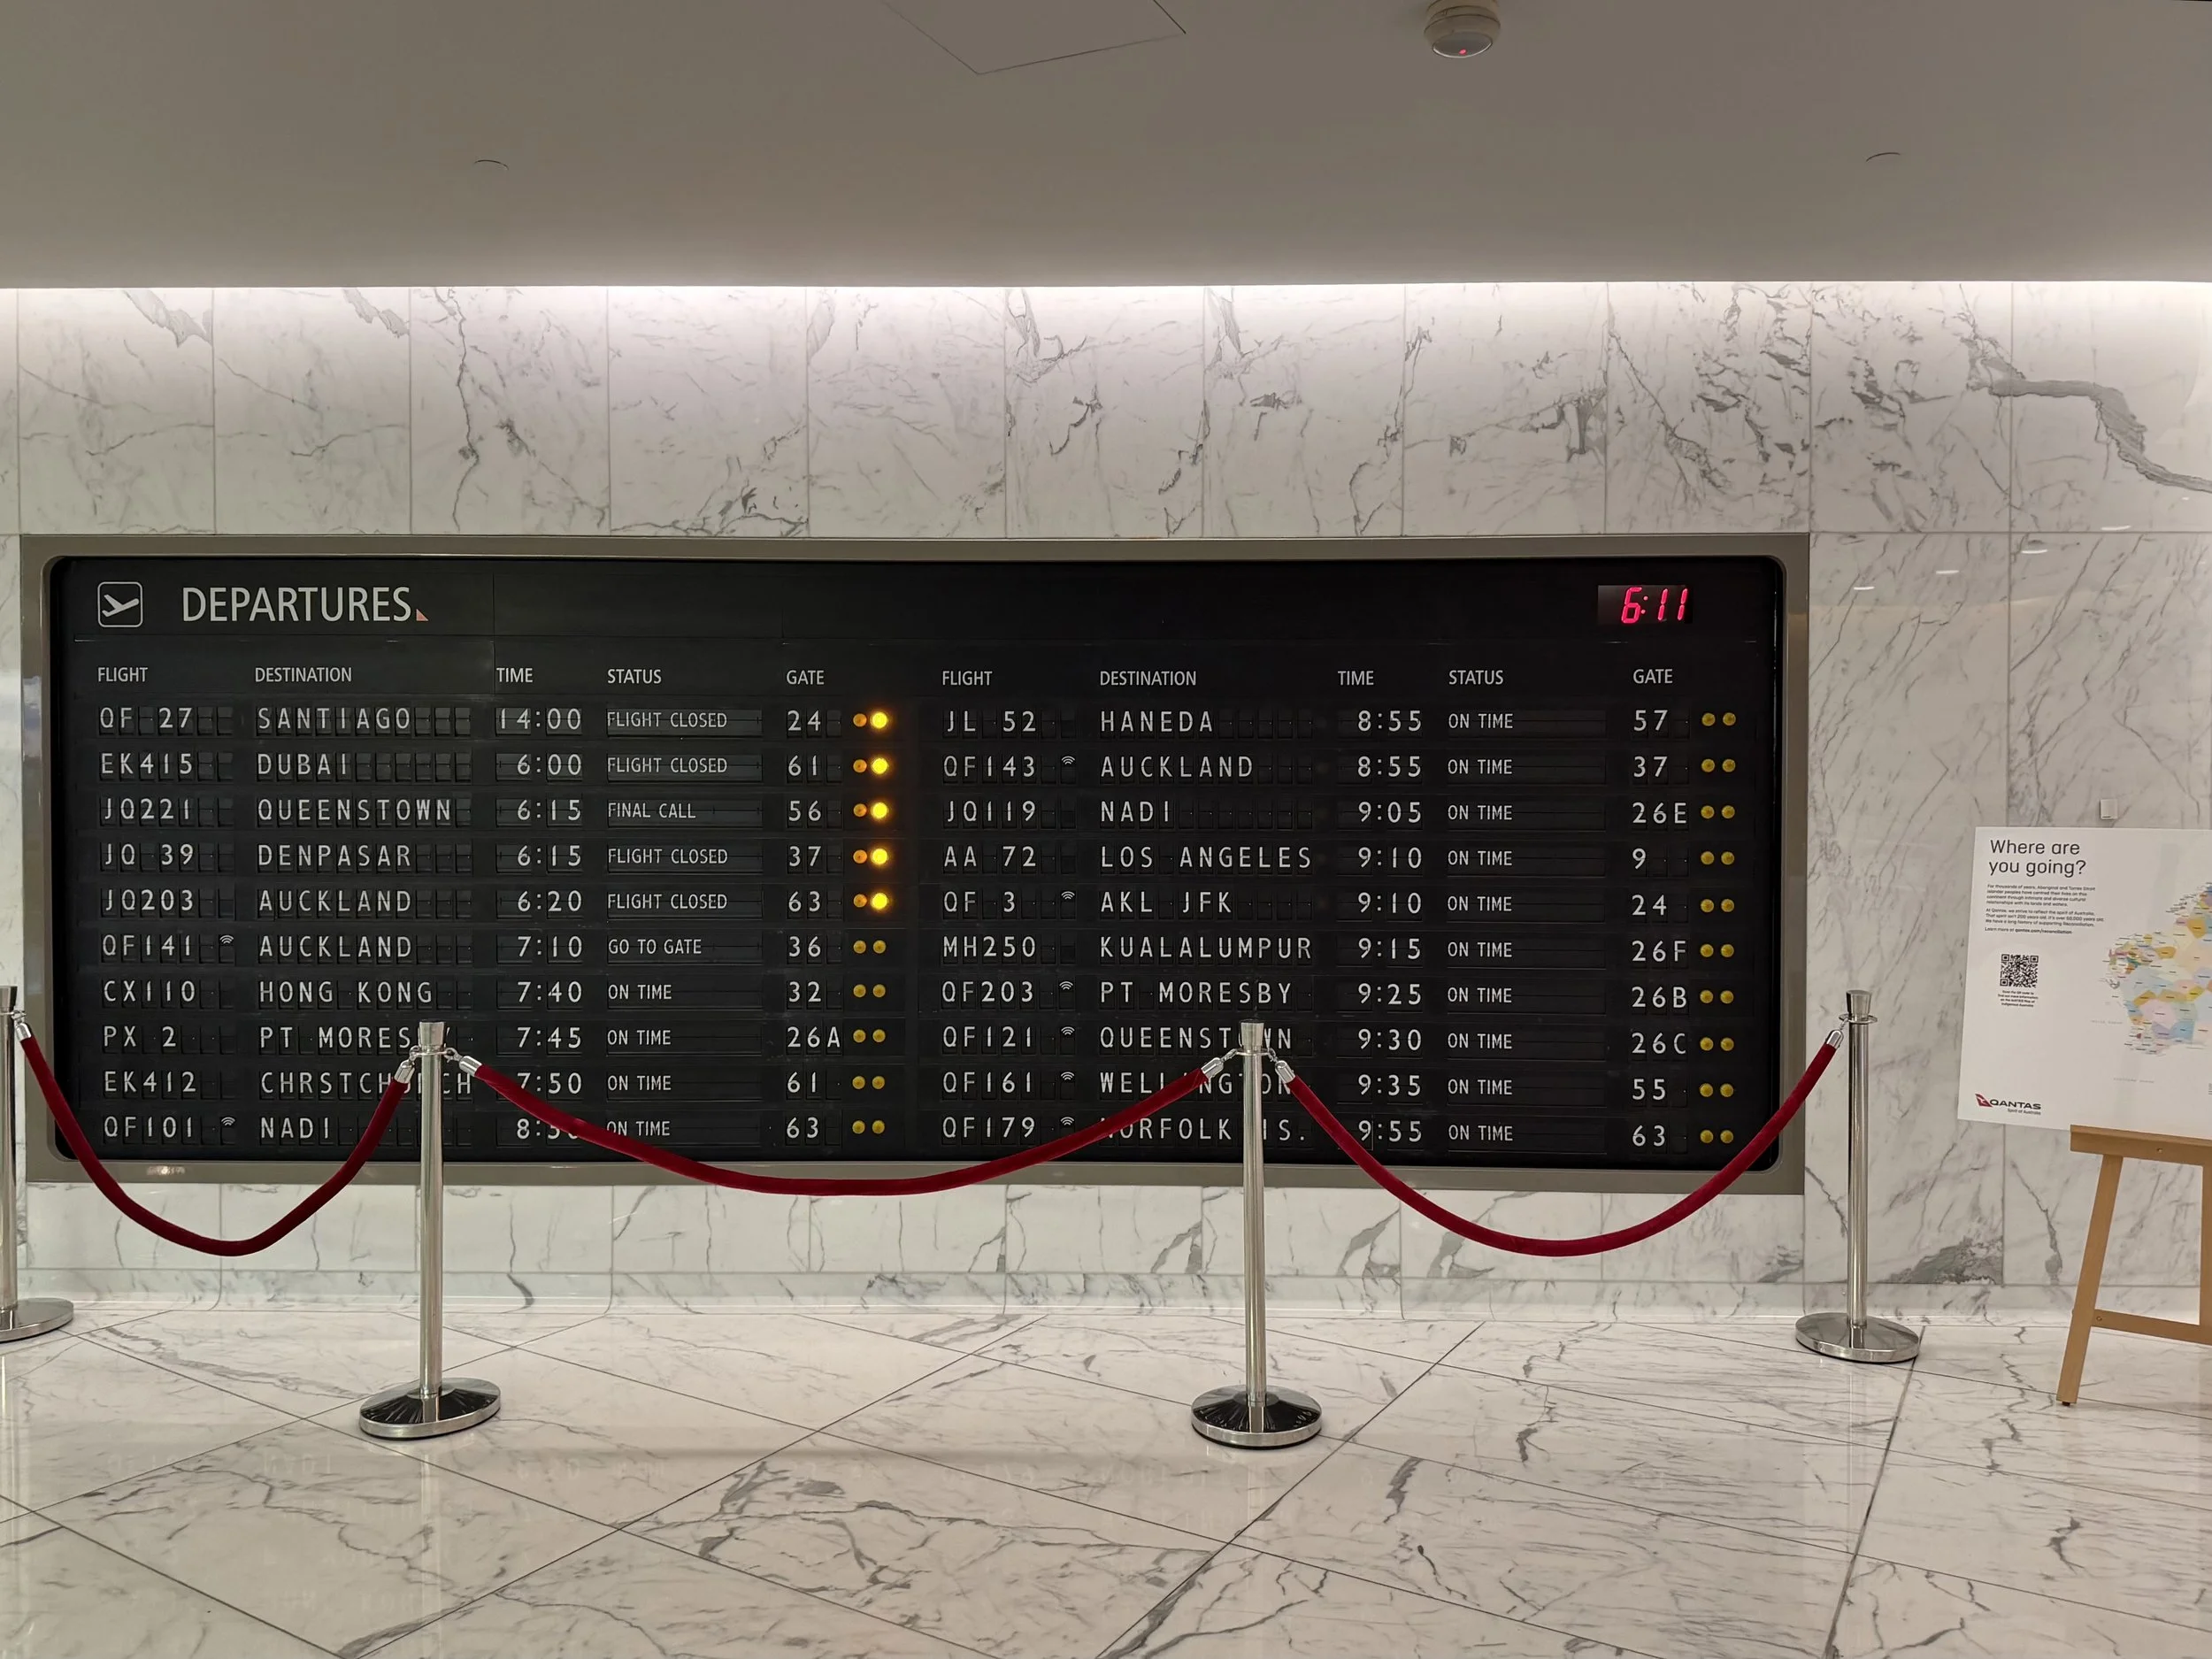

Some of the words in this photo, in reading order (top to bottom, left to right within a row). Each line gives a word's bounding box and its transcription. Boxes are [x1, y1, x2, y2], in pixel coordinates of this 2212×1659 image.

[182, 587, 411, 622] DEPARTURES
[1621, 587, 1688, 624] 6:11
[96, 665, 150, 684] FLIGHT
[254, 665, 353, 684] DESTINATION
[495, 666, 534, 684] TIME
[606, 667, 663, 685] STATUS
[785, 669, 826, 686] GATE
[941, 670, 994, 687] FLIGHT
[1099, 670, 1197, 687] DESTINATION
[1336, 669, 1375, 687] TIME
[1448, 669, 1505, 686] STATUS
[1632, 667, 1674, 685] GATE
[258, 707, 410, 729] SANTIAGO
[501, 707, 581, 730] 14:00
[607, 711, 662, 727] FLIGHT
[670, 711, 727, 728] CLOSED
[787, 710, 821, 732] 24
[1101, 710, 1212, 733] HANEDA
[1357, 710, 1421, 732] 8:55
[1448, 713, 1470, 729] ON
[1478, 713, 1513, 729] TIME
[1633, 710, 1668, 732] 57
[101, 752, 192, 774] EK415
[257, 753, 346, 775] DUBAI
[517, 753, 581, 776] 6:00
[607, 757, 662, 773] FLIGHT
[670, 757, 727, 773] CLOSED
[787, 755, 817, 777] 61
[943, 755, 1035, 778] QF143
[1101, 756, 1252, 778] AUCKLAND
[1357, 756, 1421, 778] 8:55
[1448, 759, 1469, 774] ON
[1477, 759, 1513, 774] TIME
[1633, 756, 1668, 778] 37
[104, 797, 189, 820] JQ221
[257, 798, 450, 821] QUEENSTOWN
[517, 799, 581, 821] 6:15
[608, 802, 651, 818] FINAL
[658, 803, 696, 818] CALL
[788, 800, 821, 822] 56
[947, 800, 1036, 822] JQ119
[1101, 800, 1169, 822] NADI
[1358, 801, 1421, 824] 9:05
[1448, 804, 1469, 820] ON
[1477, 804, 1513, 820] TIME
[1632, 802, 1686, 824] 26E
[258, 844, 411, 866] DENPASAR
[517, 845, 581, 867] 6:15
[608, 848, 663, 864] FLIGHT
[671, 849, 728, 864] CLOSED
[789, 845, 822, 867] 37
[1102, 846, 1153, 868] LOS
[1179, 846, 1310, 869] ANGELES
[1358, 847, 1422, 869] 9:10
[1448, 849, 1469, 865] ON
[1477, 850, 1513, 866] TIME
[1632, 848, 1647, 870] 9
[1989, 839, 2046, 856] Where
[2051, 841, 2081, 856] are
[1988, 859, 2020, 875] you
[2025, 859, 2086, 878] going?
[105, 888, 193, 911] JQ203
[259, 889, 411, 912] AUCKLAND
[518, 889, 582, 912] 6:20
[608, 893, 663, 910] FLIGHT
[670, 894, 727, 910] CLOSED
[788, 890, 821, 912] 63
[1101, 891, 1153, 913] AKL
[1182, 891, 1232, 913] JFK
[1357, 892, 1422, 914] 9:10
[1447, 895, 1469, 911] ON
[1477, 895, 1512, 911] TIME
[1632, 894, 1667, 916] 24
[103, 934, 190, 956] QF141
[259, 935, 411, 957] AUCKLAND
[518, 935, 582, 957] 7:10
[608, 939, 630, 955] GO
[637, 939, 657, 955] TO
[664, 939, 702, 955] GATE
[788, 935, 821, 957] 36
[943, 935, 1035, 957] MH250
[1101, 936, 1311, 959] KUALALUMPUR
[1358, 937, 1421, 960] 9:15
[1448, 941, 1469, 957] ON
[1477, 941, 1512, 957] TIME
[1632, 940, 1686, 963] 26F
[104, 979, 196, 1002] CX110
[259, 980, 333, 1002] HONG
[357, 981, 432, 1003] KONG
[517, 980, 582, 1003] 7:40
[608, 984, 629, 1000] ON
[637, 984, 672, 1000] TIME
[788, 980, 822, 1002] 32
[941, 980, 1033, 1002] QF203
[1101, 981, 1133, 1003] PT
[1159, 981, 1291, 1004] MORESBY
[1358, 982, 1421, 1005] 9:25
[1448, 987, 1469, 1002] ON
[1477, 987, 1512, 1003] TIME
[1632, 986, 1687, 1009] 26B
[260, 1026, 293, 1048] PT
[517, 1026, 581, 1048] 7:45
[607, 1029, 628, 1046] ON
[636, 1029, 672, 1046] TIME
[787, 1025, 841, 1048] 26A
[943, 1025, 1031, 1048] QF121
[1100, 1026, 1291, 1049] QUEENSTWN
[1358, 1028, 1422, 1051] 9:30
[1448, 1033, 1469, 1048] ON
[1477, 1033, 1512, 1049] TIME
[1632, 1032, 1686, 1055] 26C
[104, 1071, 196, 1093] EK412
[517, 1072, 582, 1094] 7:50
[607, 1075, 628, 1091] ON
[636, 1075, 672, 1091] TIME
[787, 1071, 816, 1094] 61
[943, 1071, 1031, 1094] QF161
[1358, 1074, 1421, 1096] 9:35
[1448, 1079, 1469, 1094] ON
[1477, 1079, 1513, 1095] TIME
[1632, 1078, 1666, 1101] 55
[1989, 1099, 2042, 1110] QANTAS
[104, 1116, 192, 1138] QF101
[261, 1117, 328, 1139] NADI
[606, 1120, 627, 1136] ON
[635, 1120, 671, 1136] TIME
[787, 1117, 818, 1139] 63
[942, 1117, 1035, 1138] QF179
[1101, 1117, 1232, 1141] ORFOLK
[1263, 1118, 1305, 1141] IS.
[1358, 1119, 1422, 1142] 9:55
[1448, 1125, 1470, 1141] ON
[1478, 1125, 1513, 1141] TIME
[1632, 1125, 1665, 1147] 63
